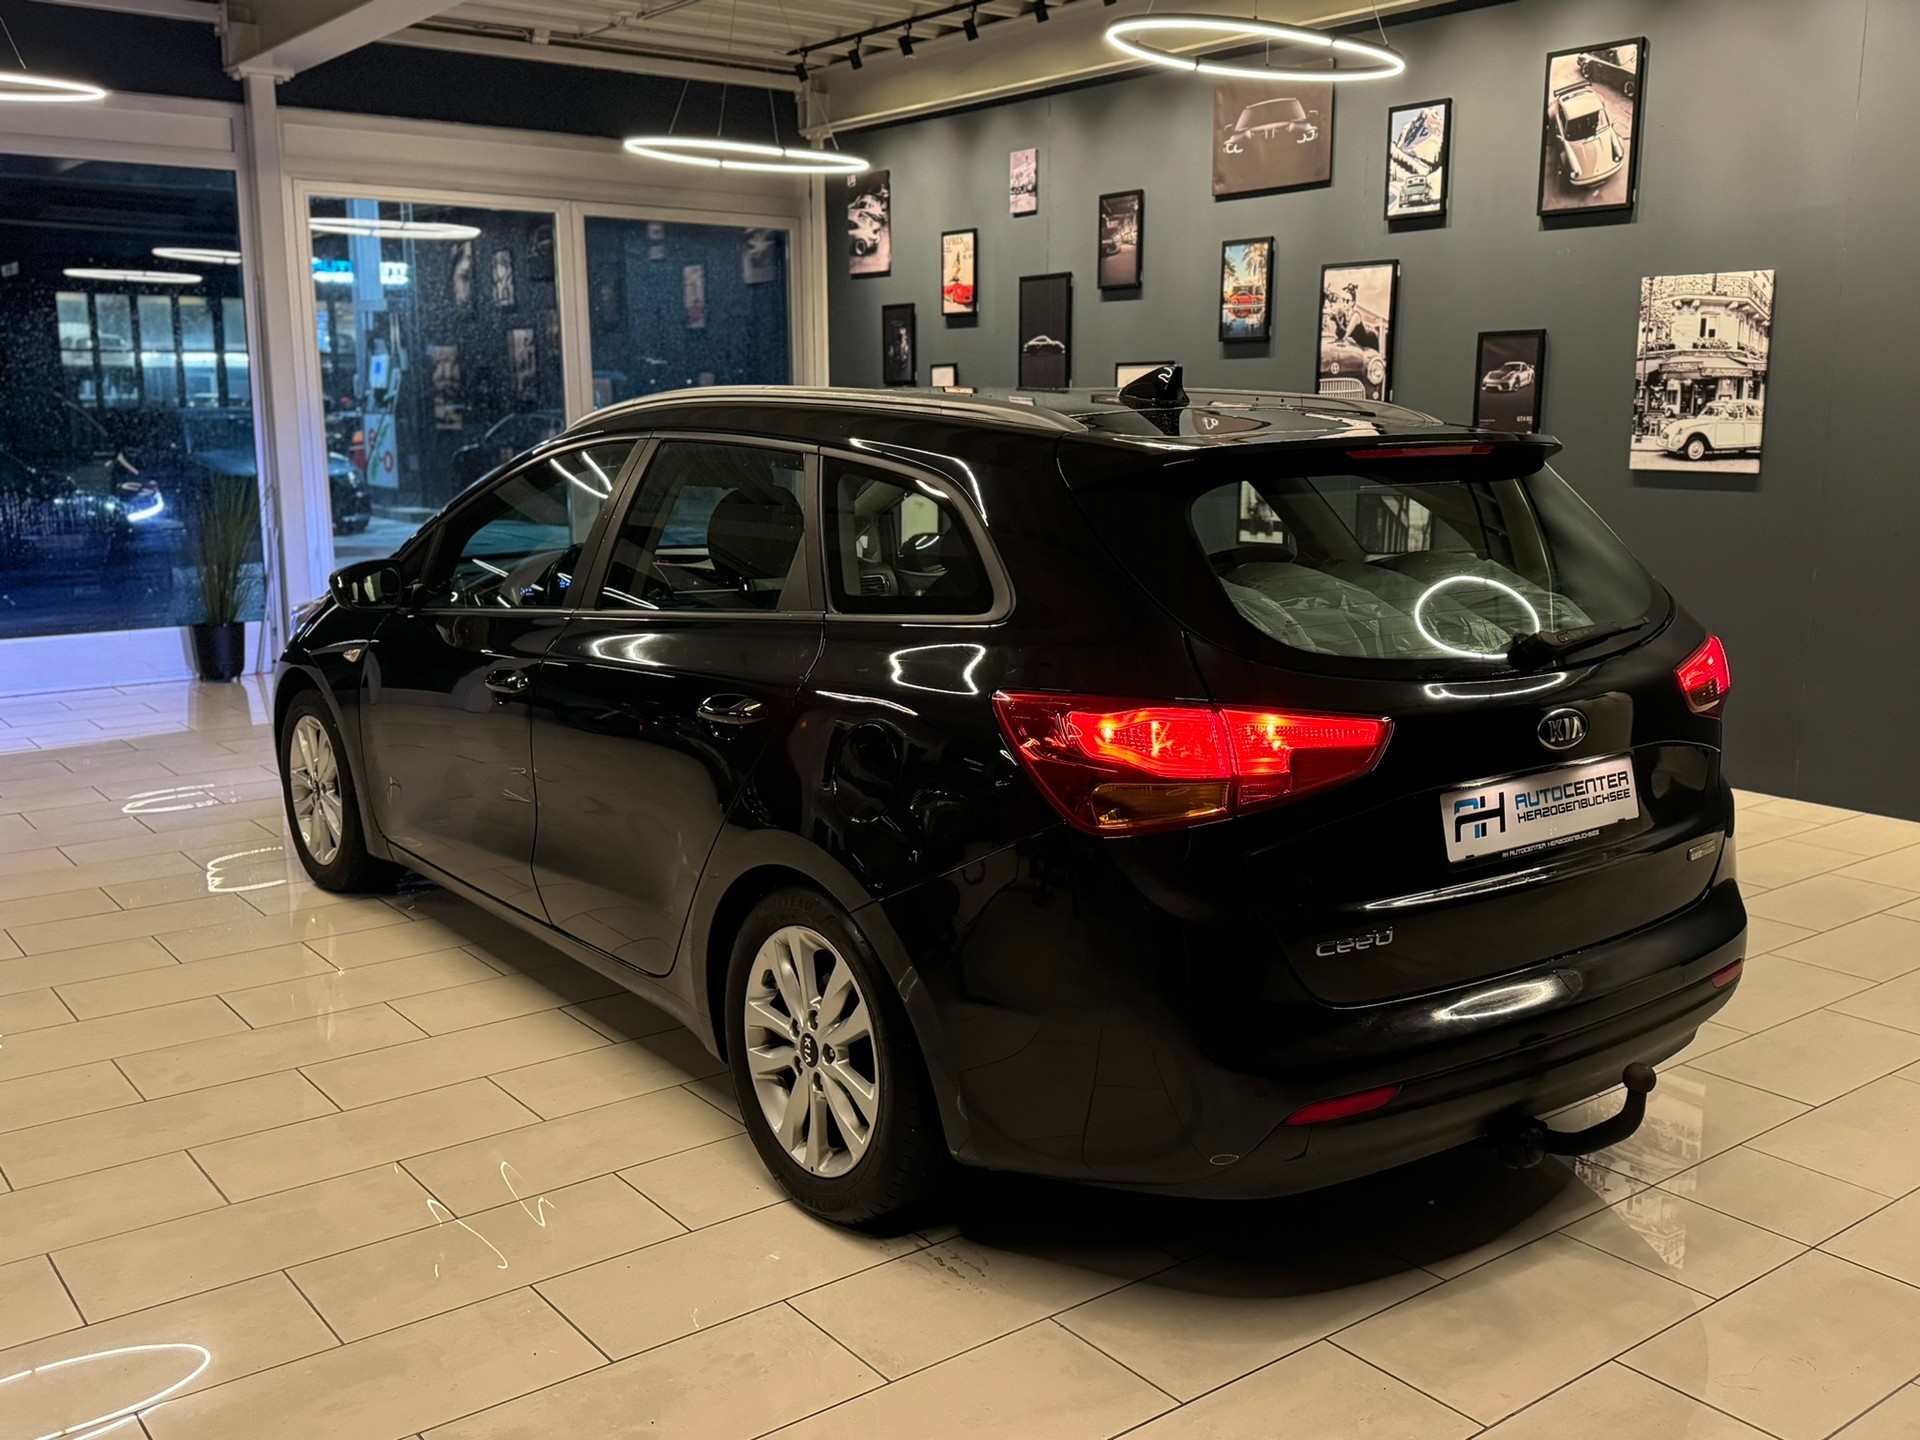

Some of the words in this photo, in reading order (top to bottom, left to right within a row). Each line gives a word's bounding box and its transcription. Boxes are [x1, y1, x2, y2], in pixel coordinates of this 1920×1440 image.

[1548, 716, 1583, 742] KIA
[1515, 771, 1629, 810] AUTOCENTER
[1517, 788, 1631, 823] HERZOGENBUCHSEE
[1509, 842, 1547, 857] AUTOCENTER
[1547, 829, 1600, 849] HERZOGENBUCHSEE
[804, 1037, 812, 1063] KIA
